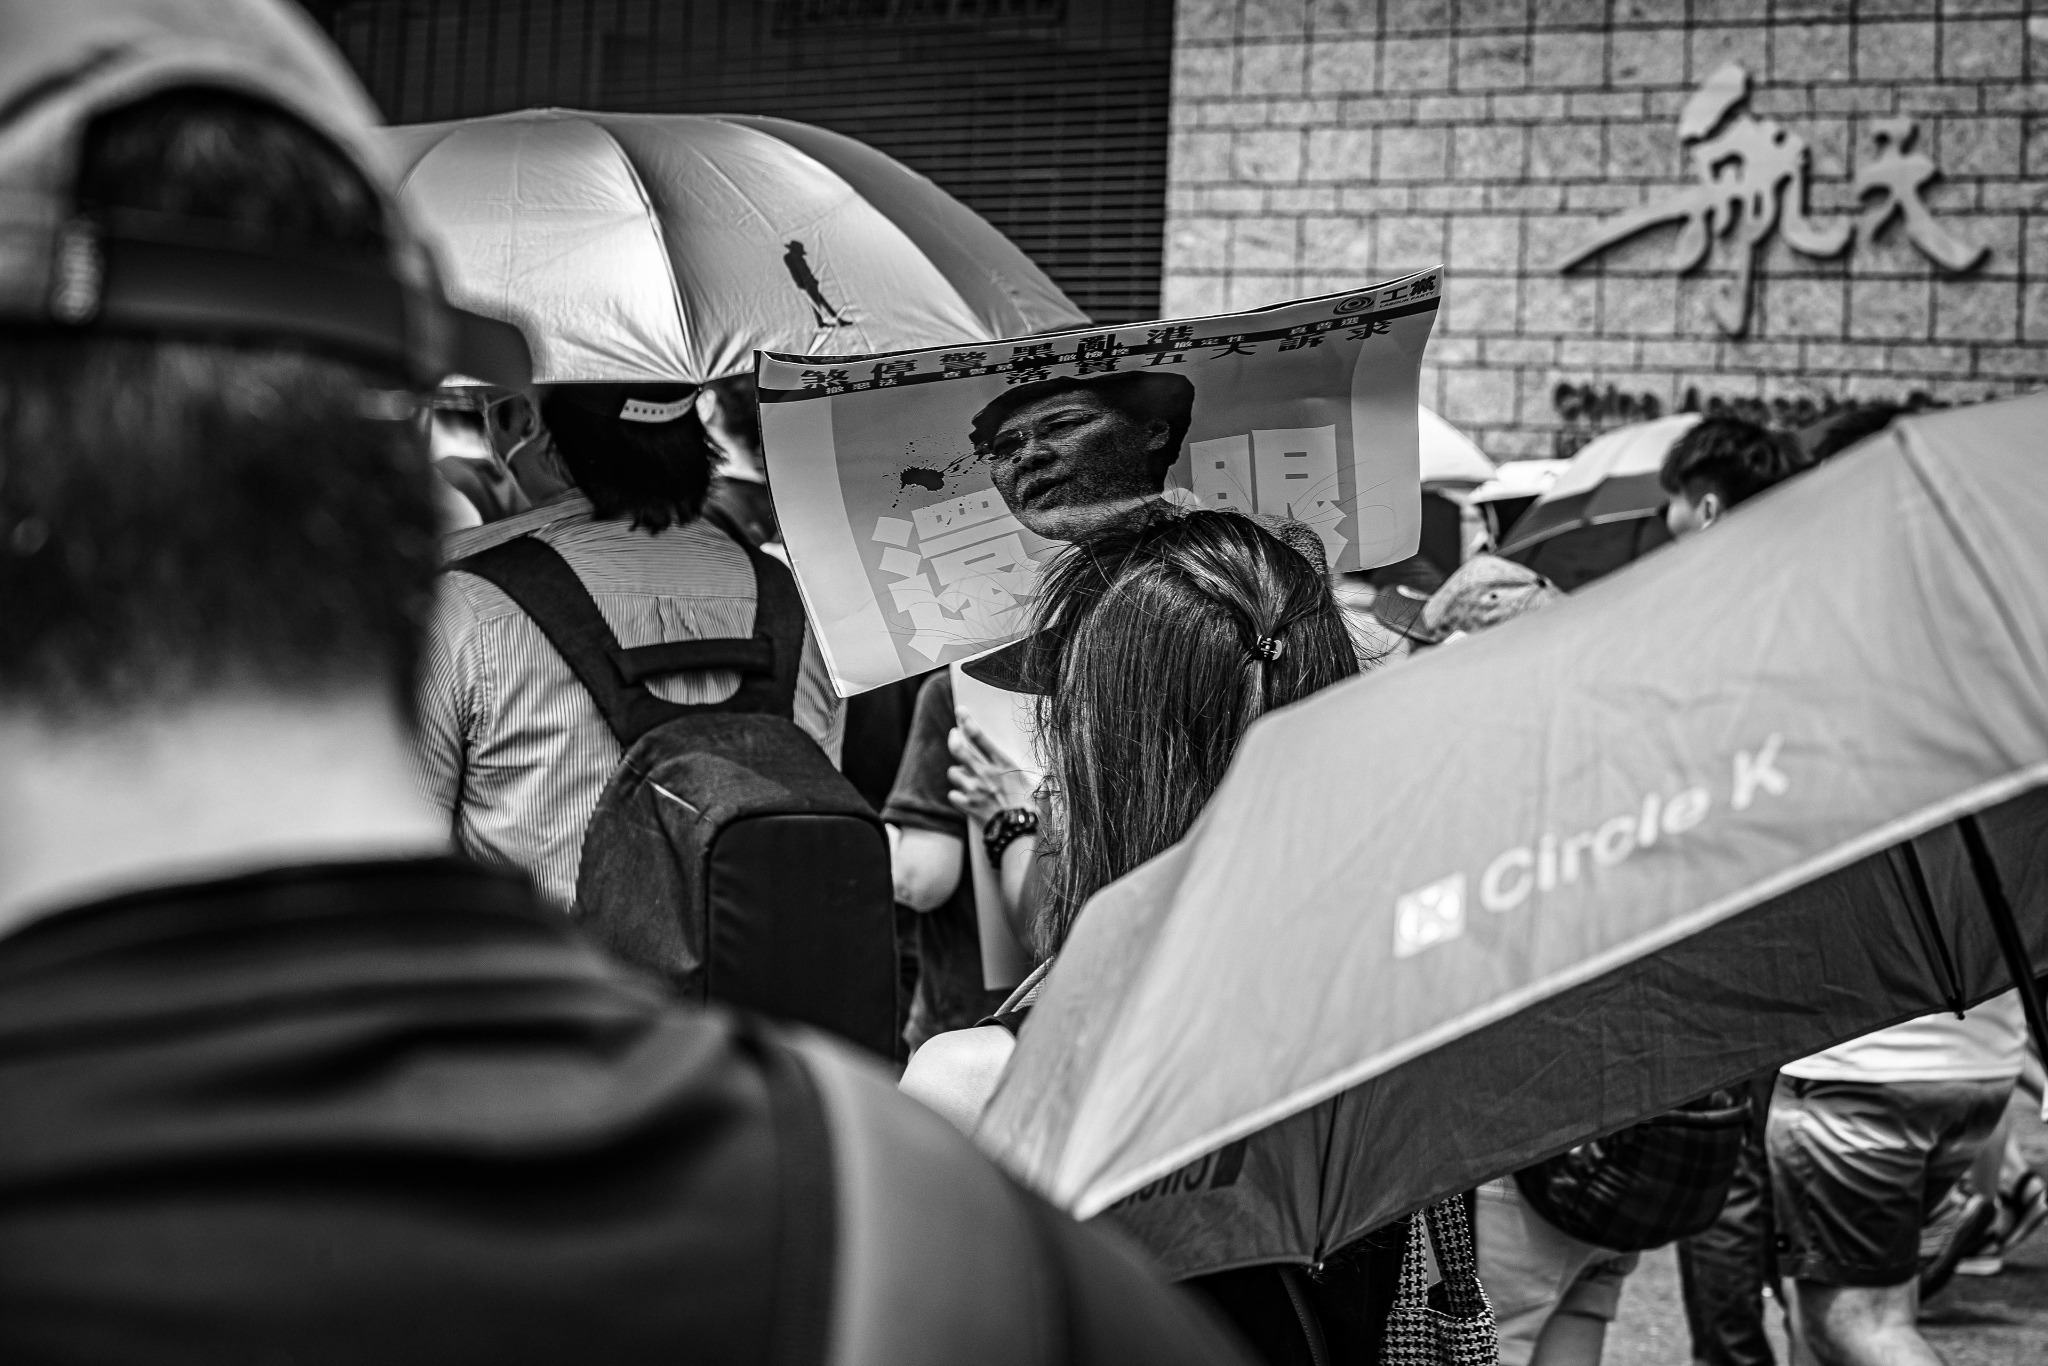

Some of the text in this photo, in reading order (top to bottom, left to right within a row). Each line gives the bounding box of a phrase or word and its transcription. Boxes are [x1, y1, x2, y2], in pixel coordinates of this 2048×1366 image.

[1379, 290, 1435, 309] LABOUR PARTY
[1479, 731, 1790, 913] Circle K
